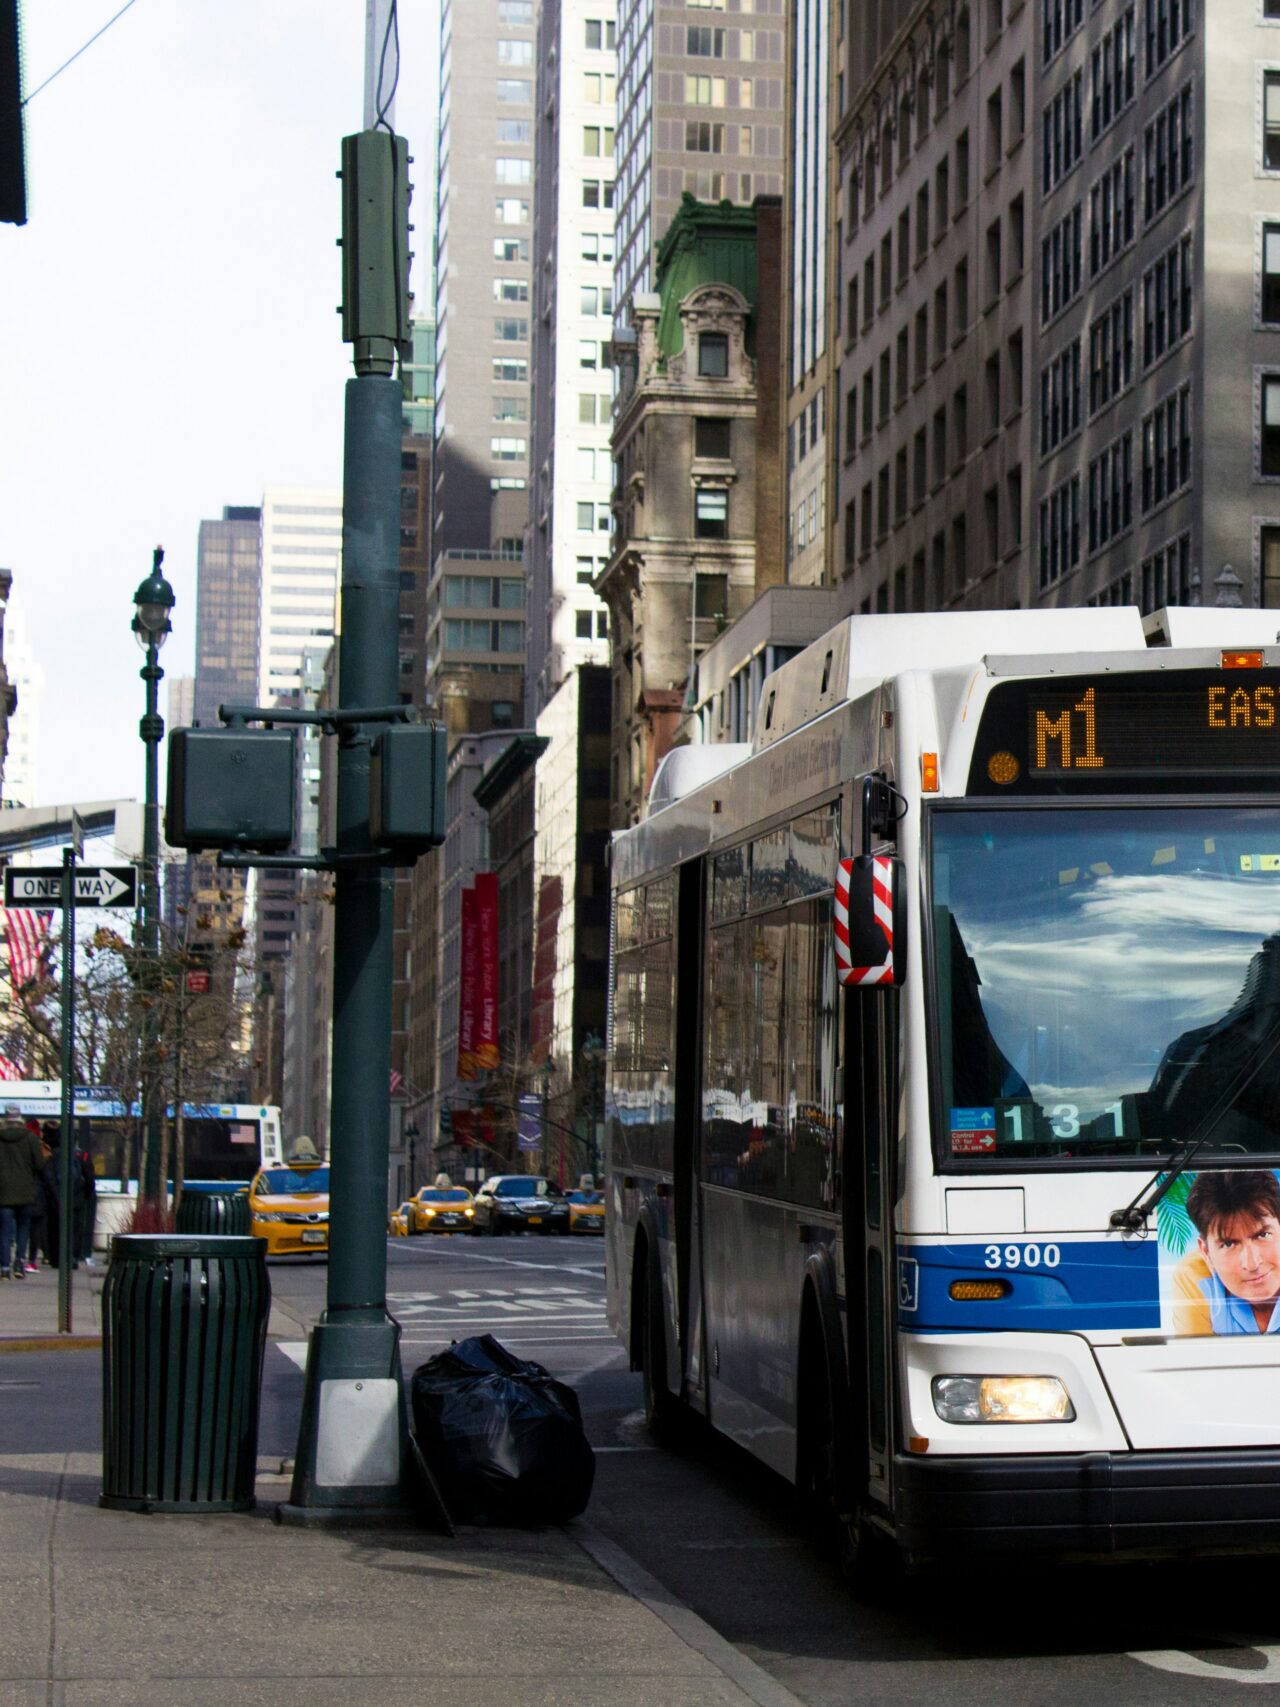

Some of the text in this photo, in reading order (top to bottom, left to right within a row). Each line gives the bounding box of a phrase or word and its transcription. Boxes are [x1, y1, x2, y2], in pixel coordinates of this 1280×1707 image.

[1037, 687, 1104, 767] M1
[24, 879, 116, 895] ONE WAY
[461, 1010, 475, 1051] Library
[481, 998, 494, 1041] Library
[984, 1243, 1061, 1269] 3900
